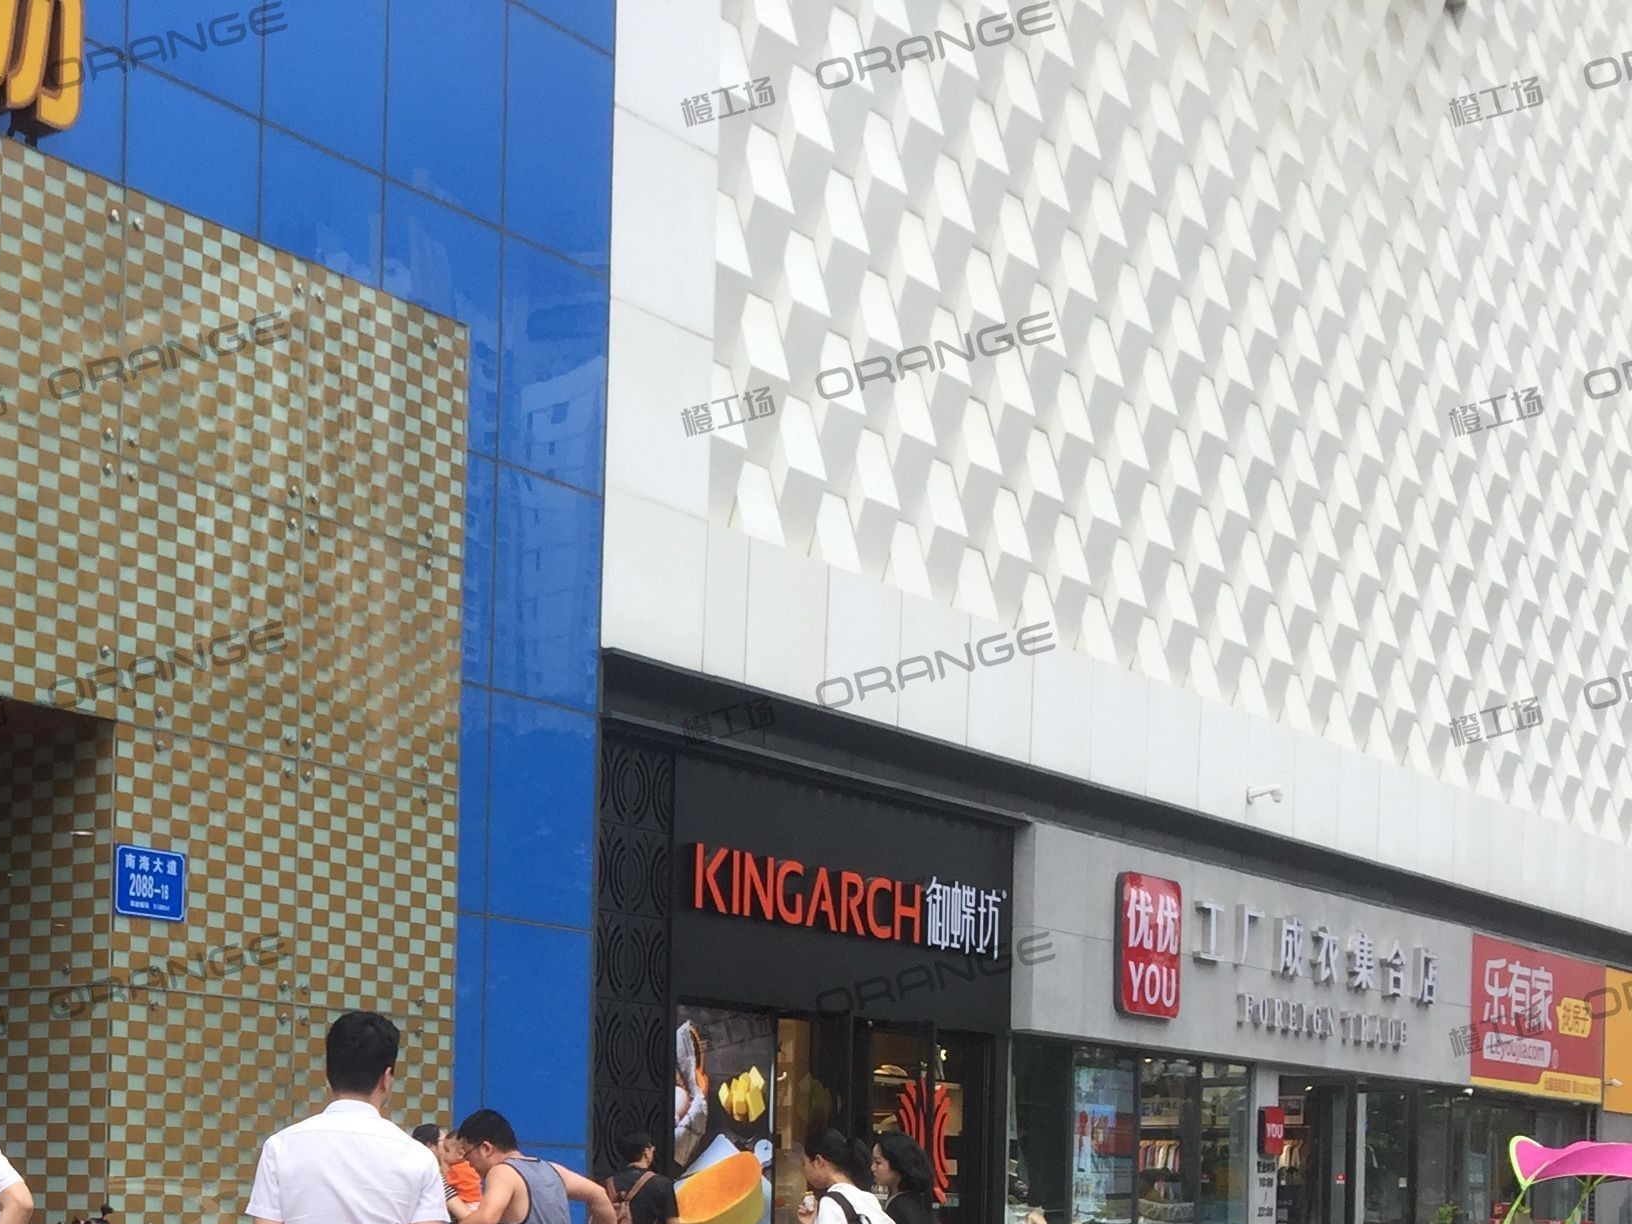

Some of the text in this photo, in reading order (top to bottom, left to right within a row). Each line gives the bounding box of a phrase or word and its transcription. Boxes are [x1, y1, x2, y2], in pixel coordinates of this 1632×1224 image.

[125, 854, 178, 876] 南海大道
[694, 843, 1002, 960] KINGARCH 御蝶坊
[1127, 888, 1180, 955] 优优
[1194, 901, 1439, 1004] 工厂成衣集合店
[1129, 961, 1176, 1007] YOU
[1483, 958, 1555, 1031] 乐有家
[1243, 992, 1408, 1047] FOREIGN TRADE
[1266, 1123, 1284, 1139] YOU
